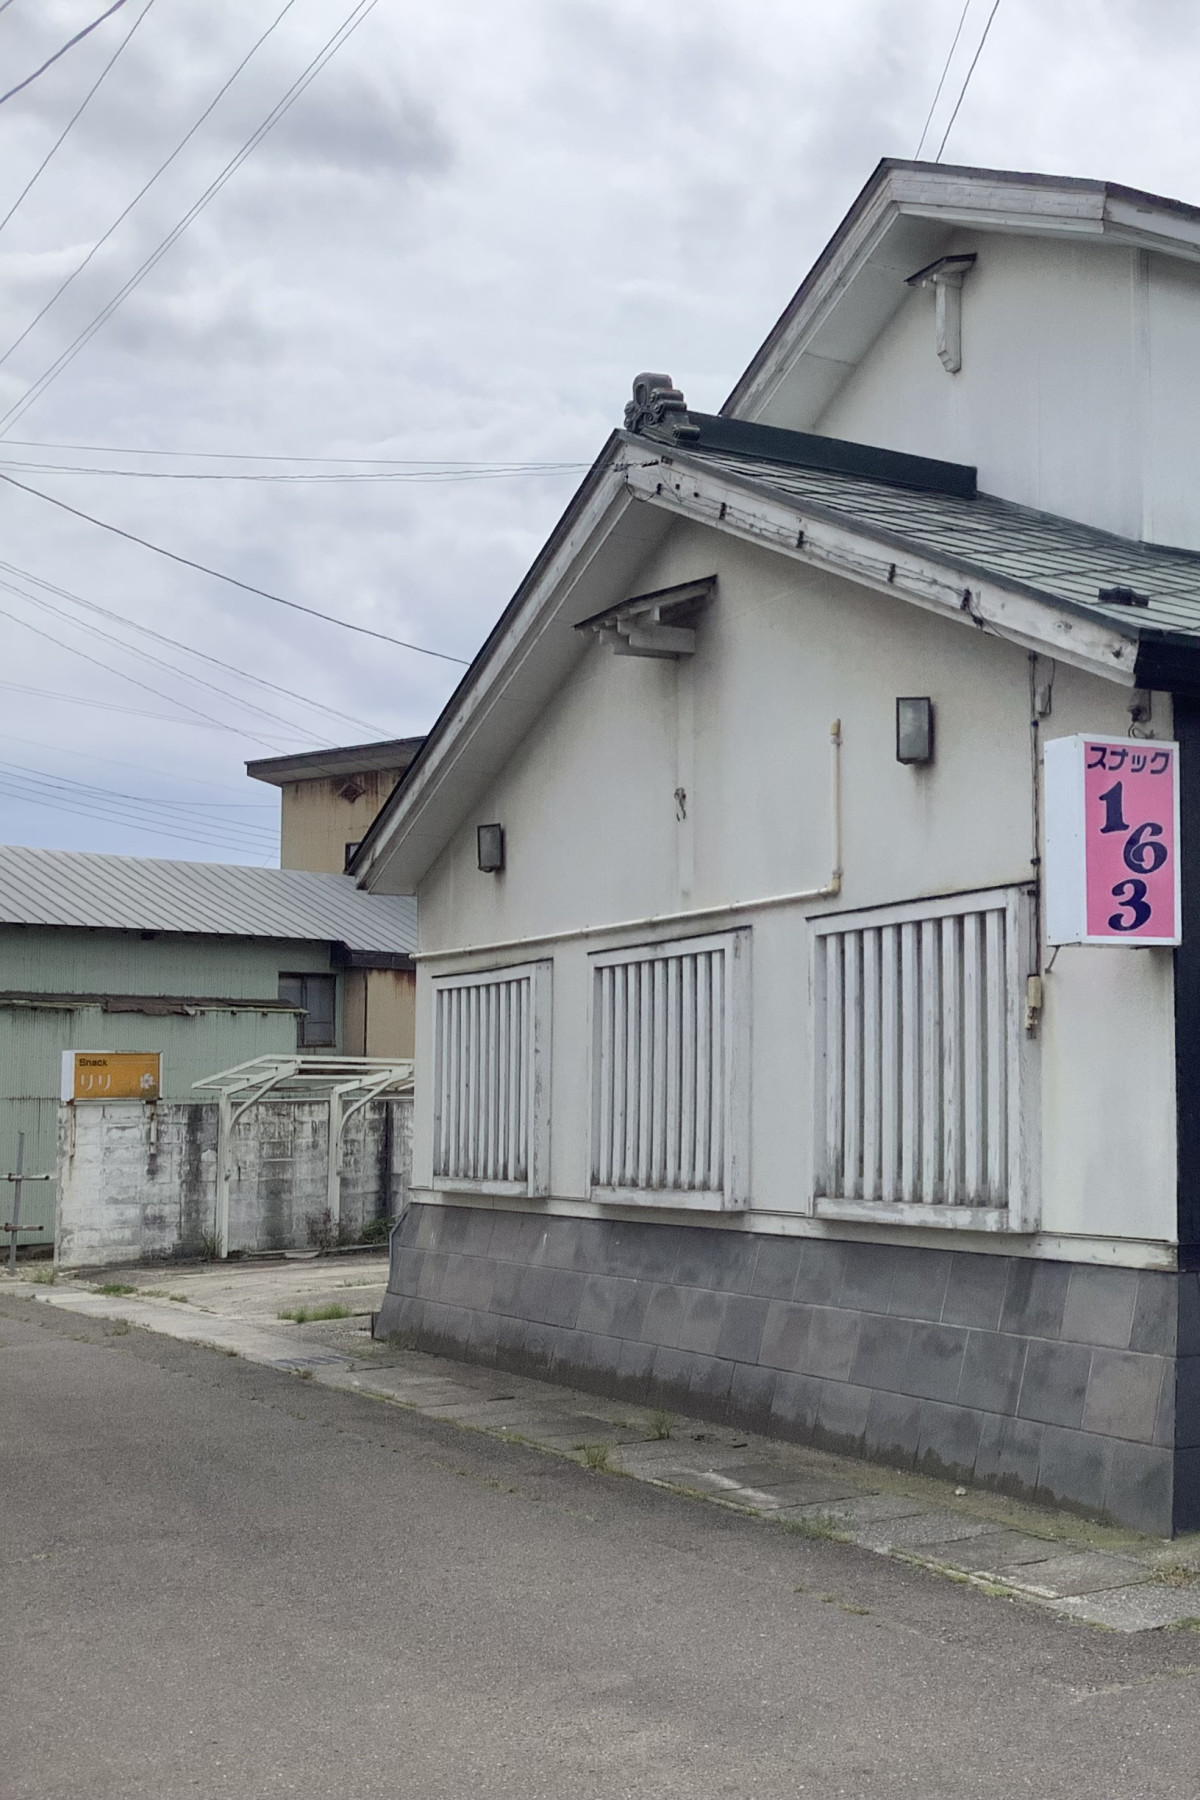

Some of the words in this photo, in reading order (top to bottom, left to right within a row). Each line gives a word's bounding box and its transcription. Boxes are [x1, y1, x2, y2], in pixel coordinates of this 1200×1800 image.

[1087, 746, 1170, 774] スナック
[1098, 780, 1168, 931] 163
[78, 1058, 108, 1067] Snack
